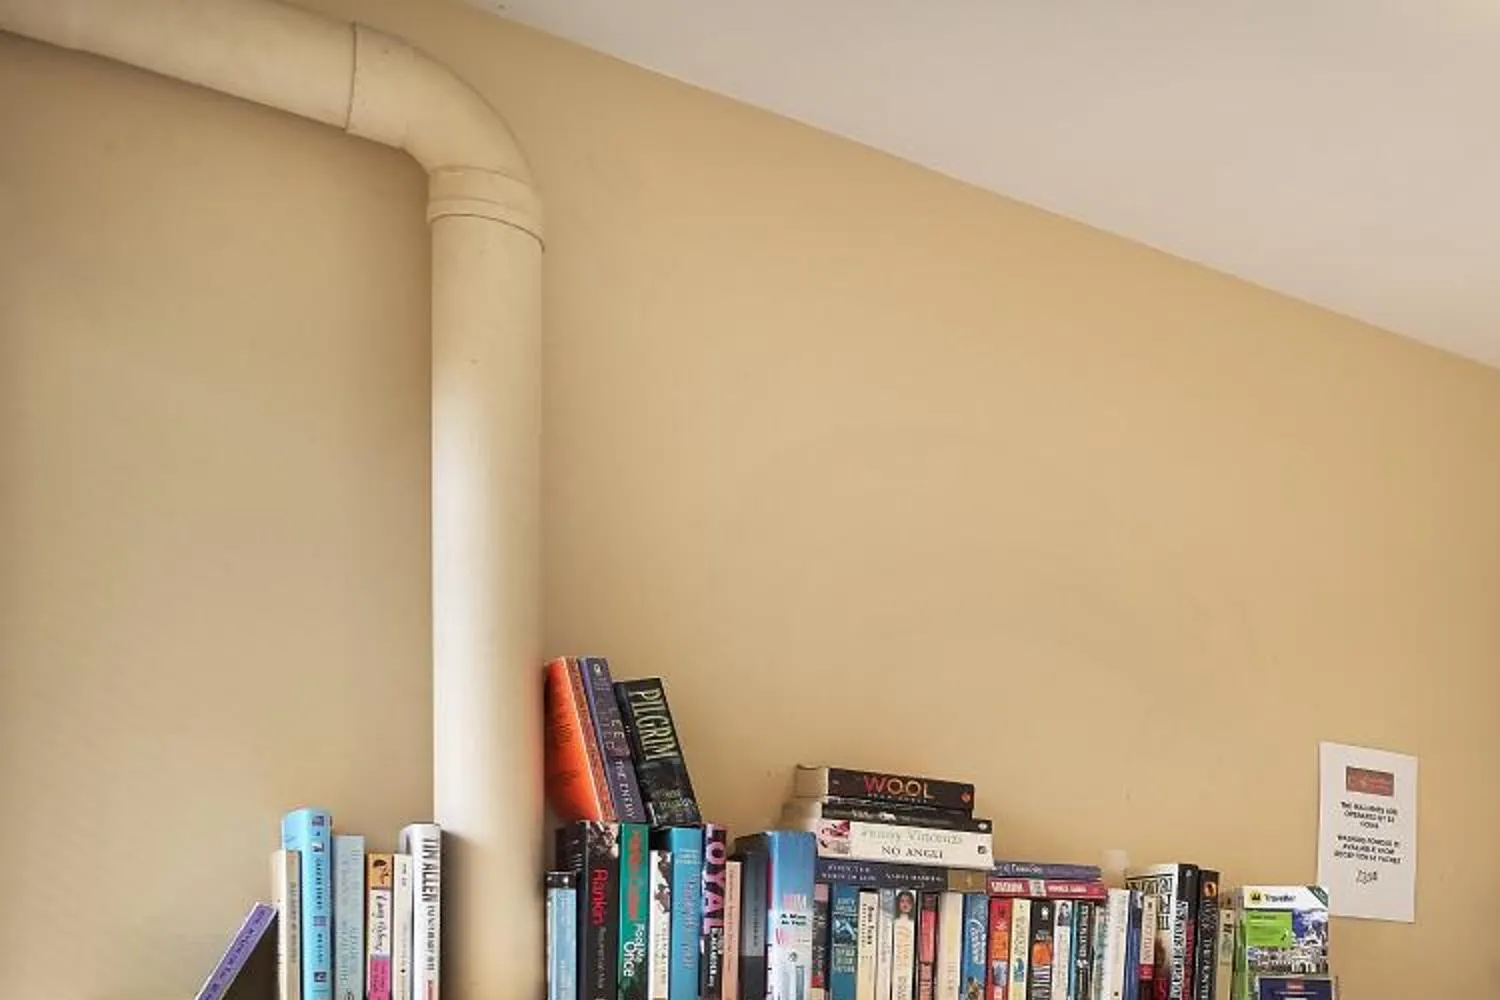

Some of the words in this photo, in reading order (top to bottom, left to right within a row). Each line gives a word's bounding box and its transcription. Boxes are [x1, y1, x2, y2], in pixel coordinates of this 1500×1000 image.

[628, 688, 678, 761] PILGRIM
[863, 775, 935, 799] WOOL
[421, 837, 438, 860] TIM
[882, 846, 900, 856] NO
[421, 862, 438, 902] ALLEN
[591, 868, 609, 925] Rankin
[704, 823, 727, 934] LOYAL
[624, 941, 637, 977] Once
